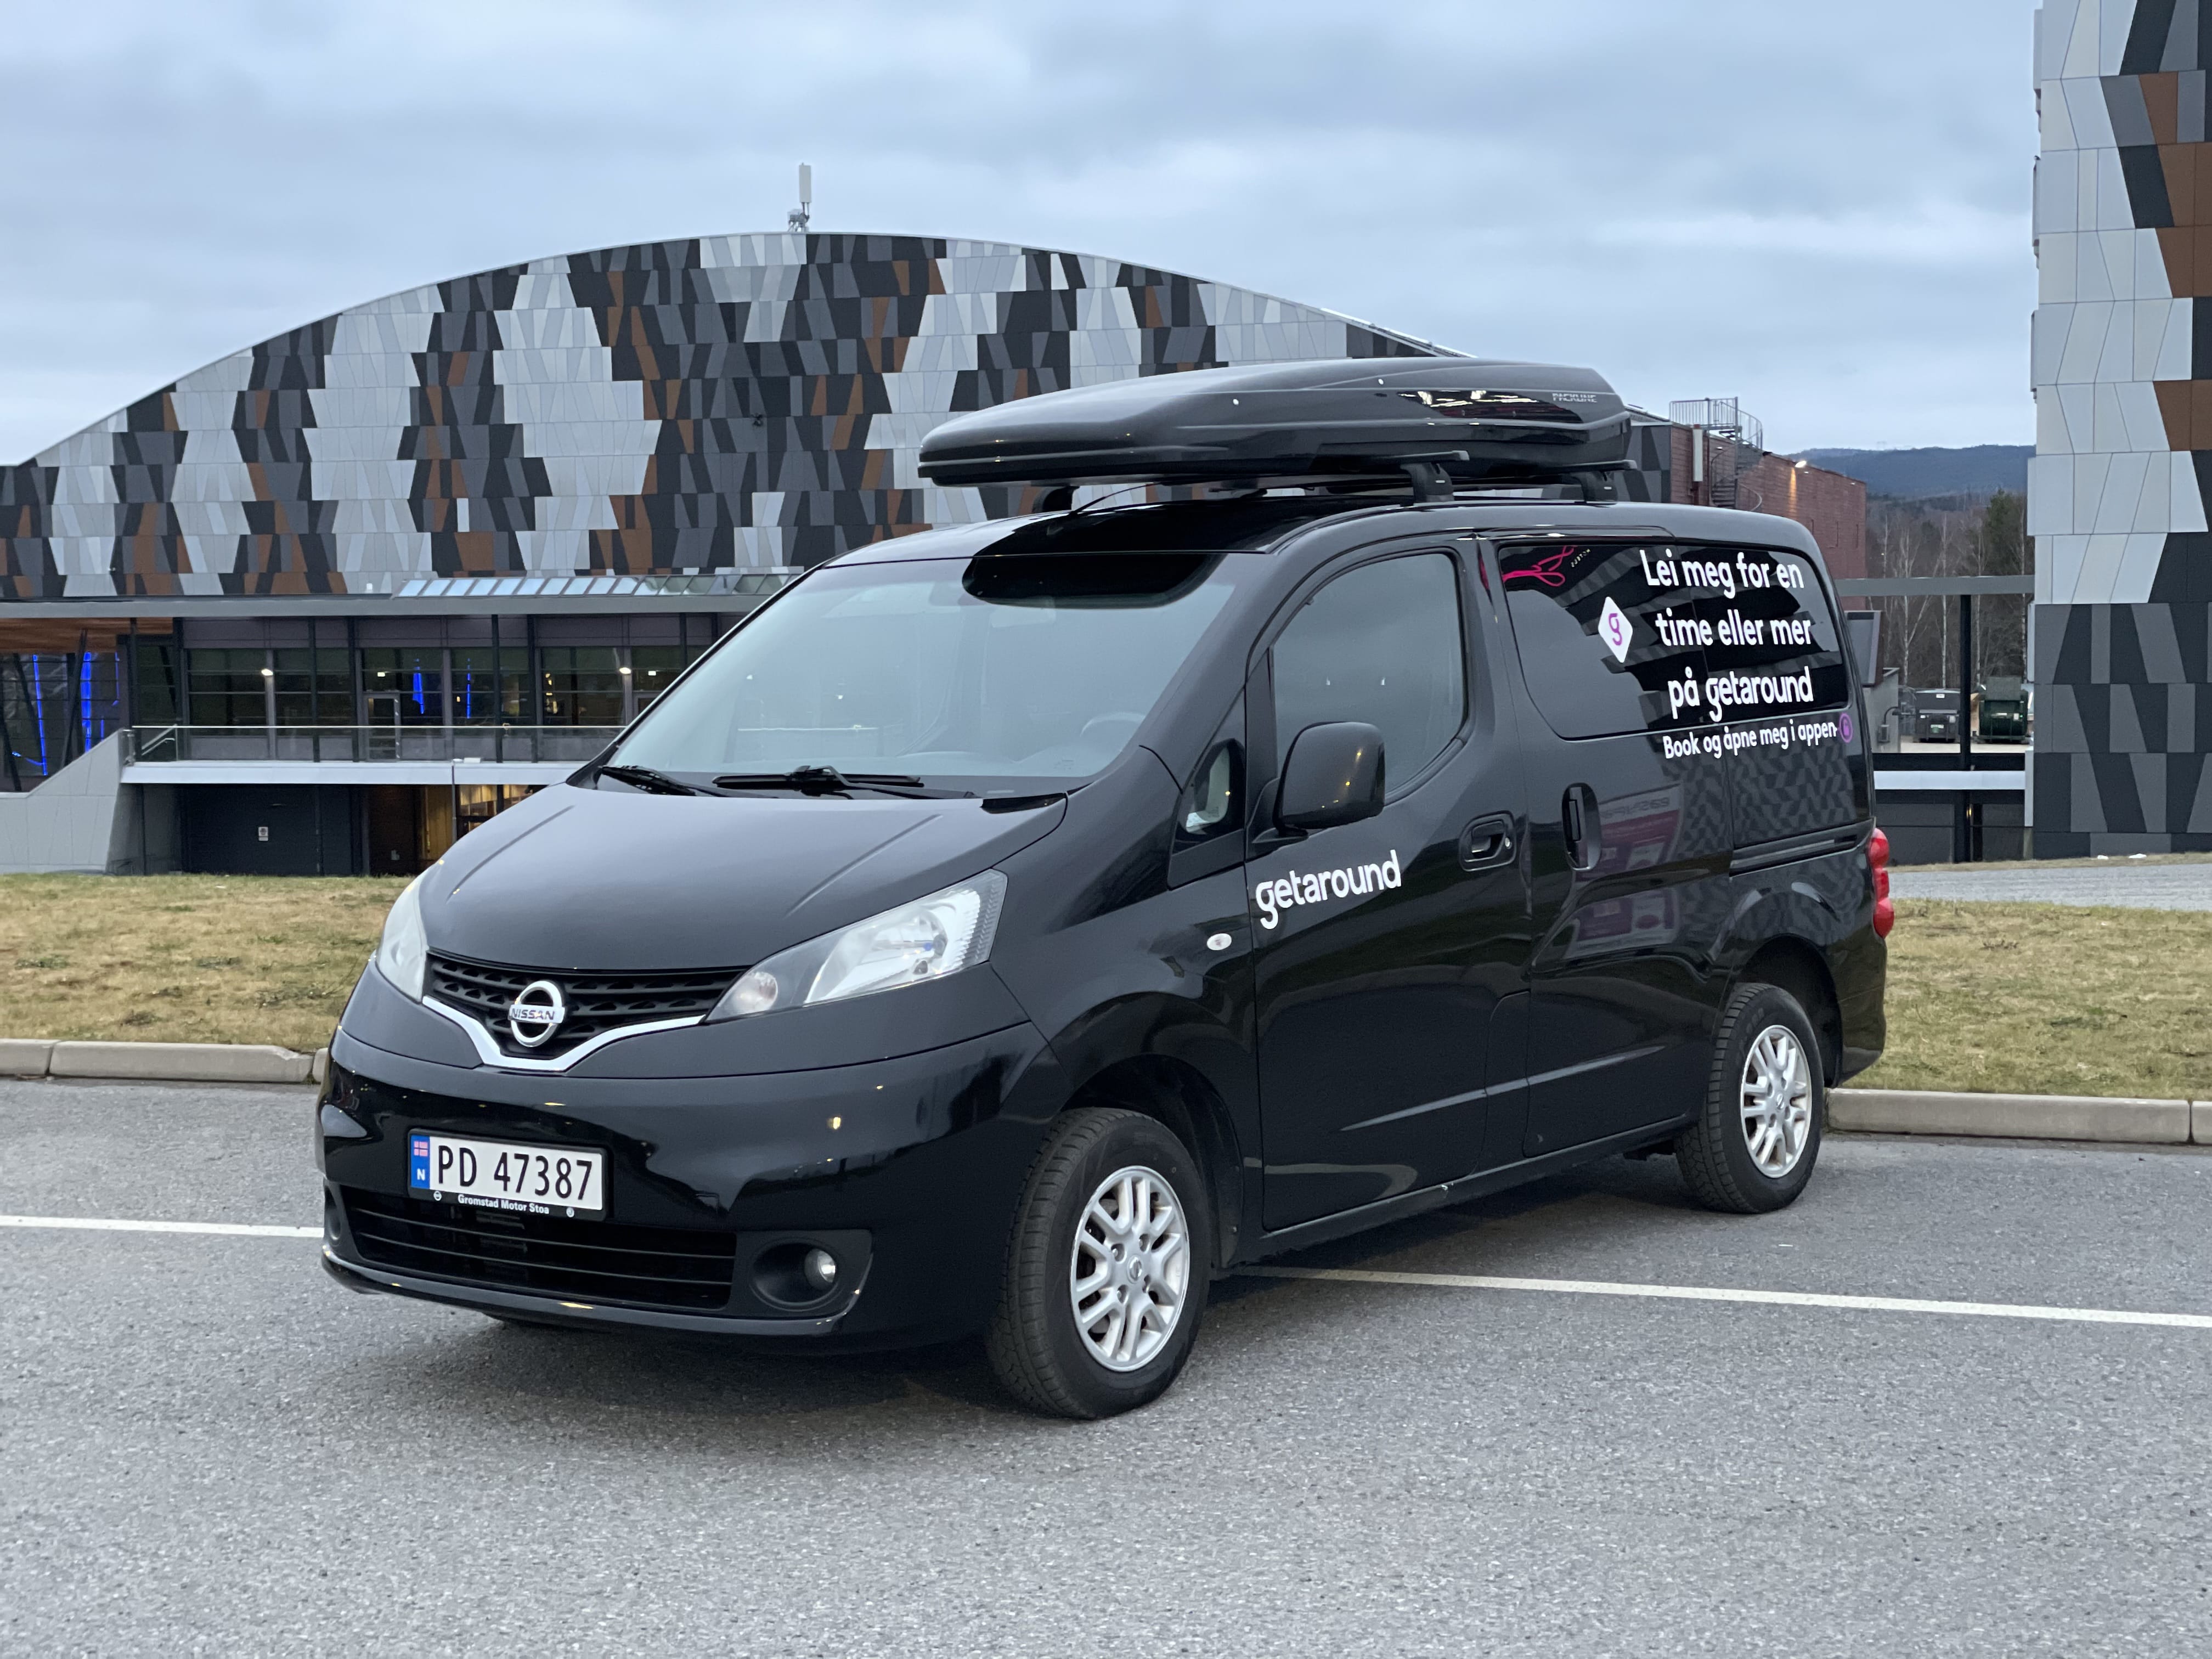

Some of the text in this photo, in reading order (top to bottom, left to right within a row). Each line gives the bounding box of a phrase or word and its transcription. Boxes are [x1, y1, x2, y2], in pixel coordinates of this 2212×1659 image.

[1552, 393, 1598, 403] PACKLINE
[1639, 548, 1804, 599] Lei meg for en
[1655, 607, 1811, 646] time eller mer
[1668, 665, 1814, 722] på getaround
[1663, 720, 1836, 759] Book og åpne meg i appen
[1255, 849, 1402, 929] getaround
[511, 1008, 555, 1020] NISSAN
[417, 1169, 425, 1181] N
[438, 1145, 592, 1200] PD 47387
[458, 1194, 549, 1214] Gromstad Motor Stoa
